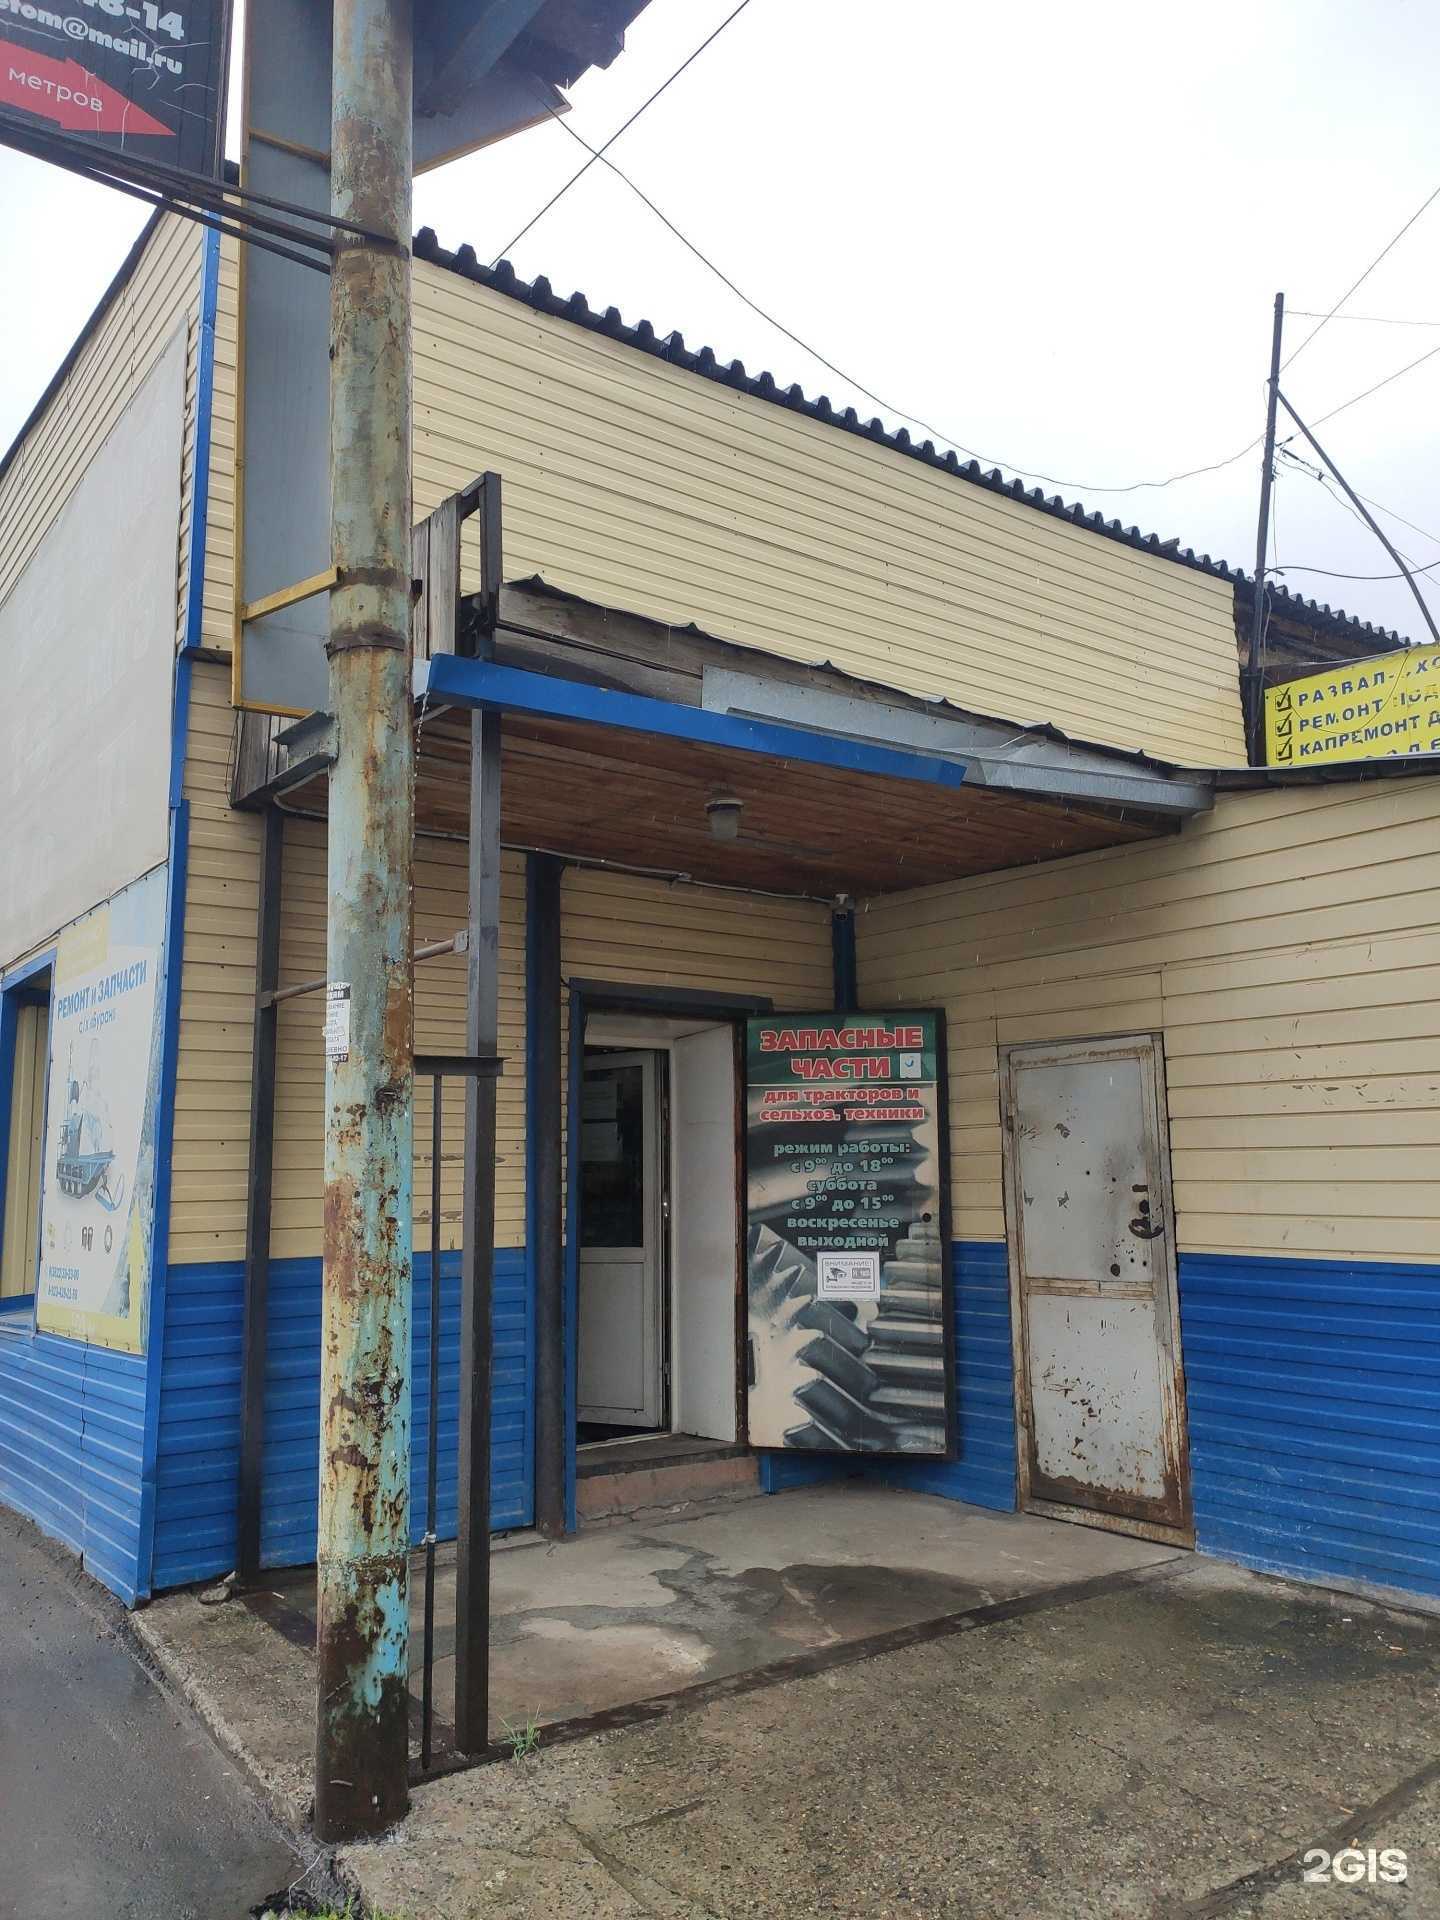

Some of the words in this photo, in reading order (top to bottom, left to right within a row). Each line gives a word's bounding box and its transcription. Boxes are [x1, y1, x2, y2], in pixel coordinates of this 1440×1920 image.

[8, 67, 103, 112] метров
[1299, 698, 1383, 732] РЕМОНТ
[1299, 714, 1421, 757] КАПРЕМОНТ
[57, 986, 90, 1020] РЕМОНТ
[98, 959, 147, 1003] ЗАПЧАСТИ
[760, 1027, 924, 1051] ЗАПАСНЫЕ
[791, 1056, 891, 1080] ЧАСТИ
[763, 1088, 799, 1104] для
[803, 1087, 903, 1105] тракторов
[907, 1088, 920, 1101] и
[760, 1108, 841, 1122] сельхоз.
[845, 1107, 925, 1121] техники
[774, 1144, 833, 1157] режим
[837, 1141, 911, 1156] работы:
[831, 1160, 855, 1175] до
[807, 1177, 878, 1194] суббота
[831, 1197, 855, 1212] до
[787, 1217, 900, 1232] воскресенье
[797, 1233, 889, 1250] выходной
